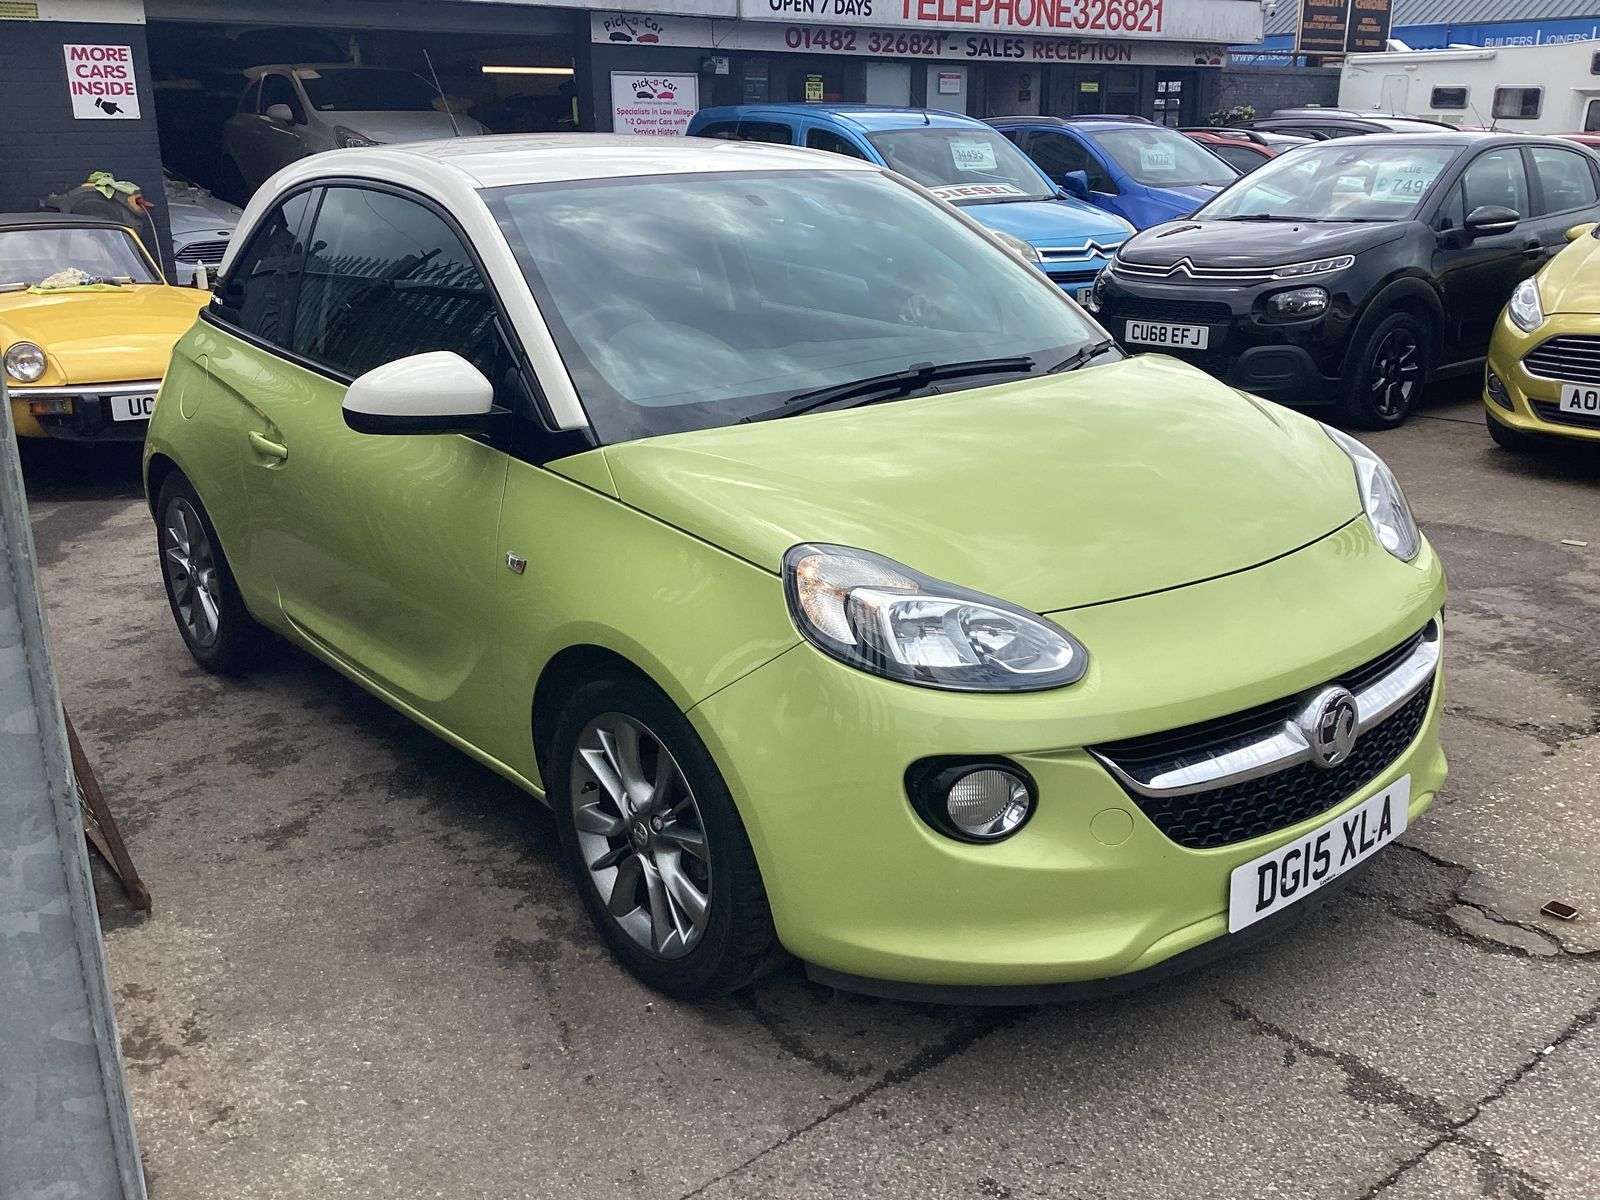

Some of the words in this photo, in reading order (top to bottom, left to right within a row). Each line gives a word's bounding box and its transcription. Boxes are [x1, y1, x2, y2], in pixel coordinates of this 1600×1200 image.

[769, 0, 814, 13] OPEN
[834, 0, 872, 16] DAYS
[603, 14, 663, 34] Pick-a-Car
[785, 27, 857, 50] 01482
[868, 31, 944, 55] 326821
[966, 37, 1025, 58] SALES
[1032, 40, 1132, 61] RECEPTION
[1485, 36, 1533, 47] BUILDERS
[71, 47, 128, 61] MORE
[75, 64, 127, 78] CARS
[71, 82, 135, 95] INSIDE
[631, 78, 678, 92] Pick-a-Car
[616, 108, 650, 116] Specialists
[1131, 323, 1168, 342] CU68
[1171, 327, 1201, 346] EFJ
[1255, 831, 1331, 913] DG15
[1340, 794, 1392, 867] XLA
